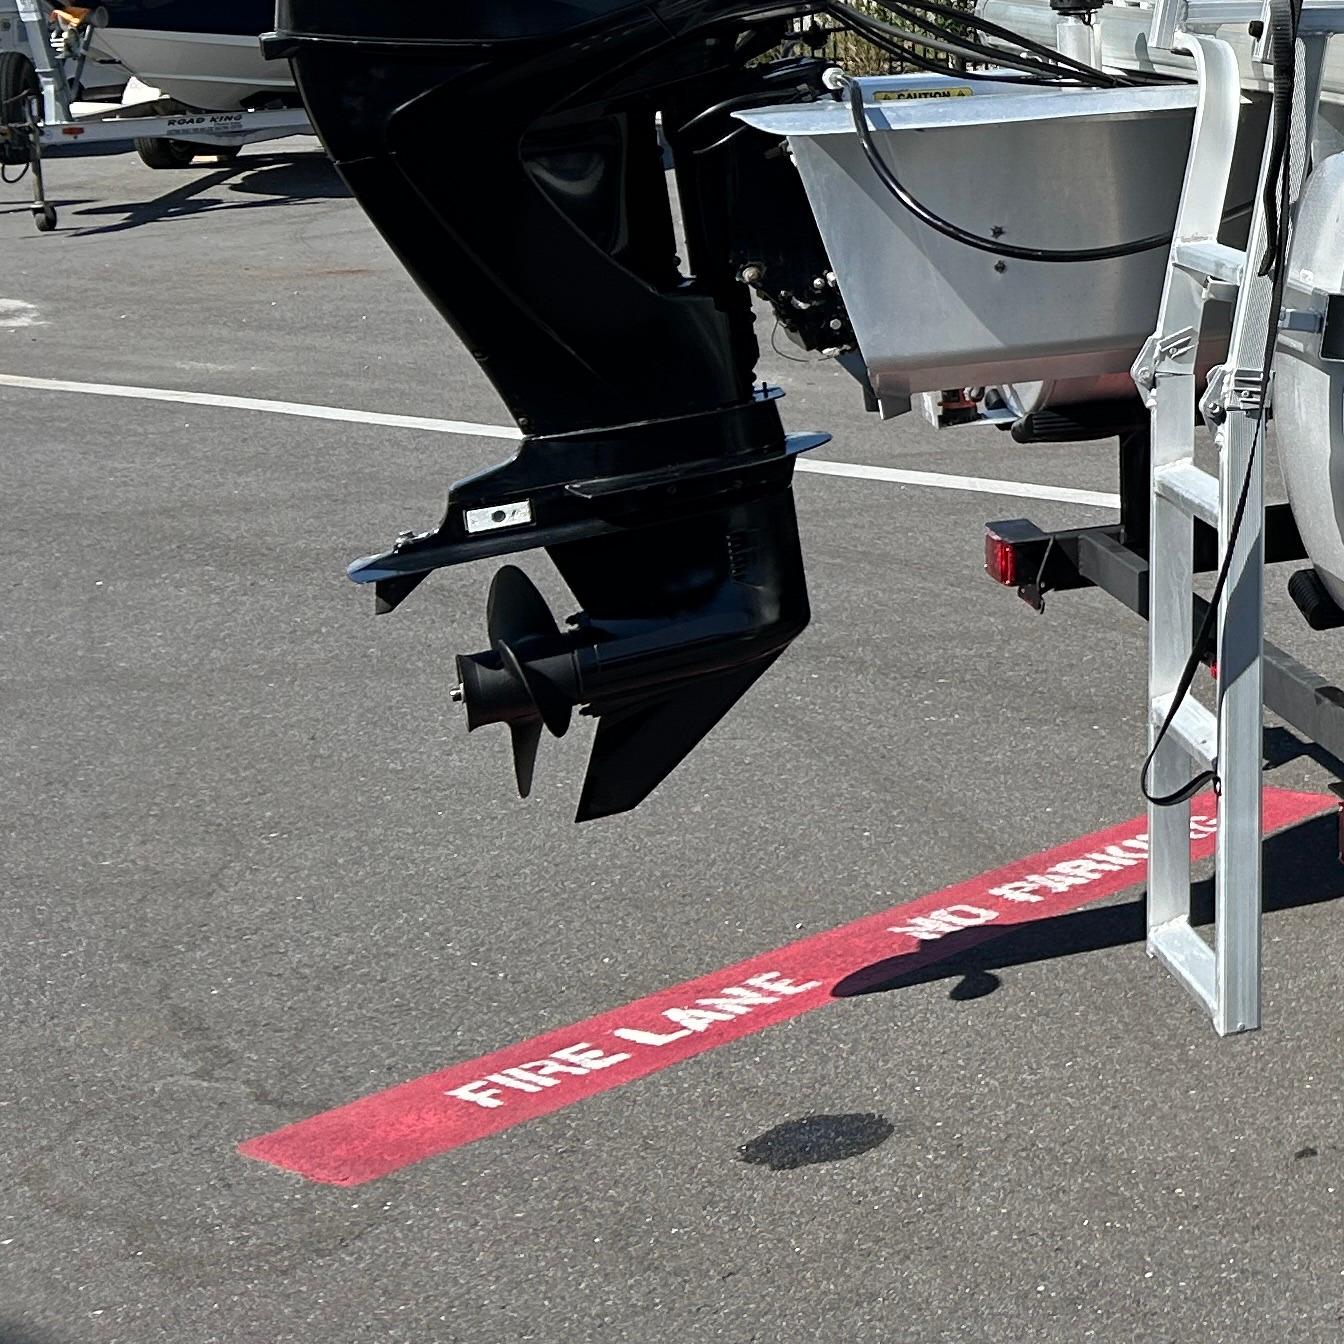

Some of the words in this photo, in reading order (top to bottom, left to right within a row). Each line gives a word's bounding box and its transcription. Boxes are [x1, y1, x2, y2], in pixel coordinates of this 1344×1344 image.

[897, 91, 951, 100] CAUTION
[167, 117, 206, 126] ROAD
[444, 1041, 632, 1109] FIRE
[613, 970, 823, 1047] LANE
[886, 904, 1000, 940] NO
